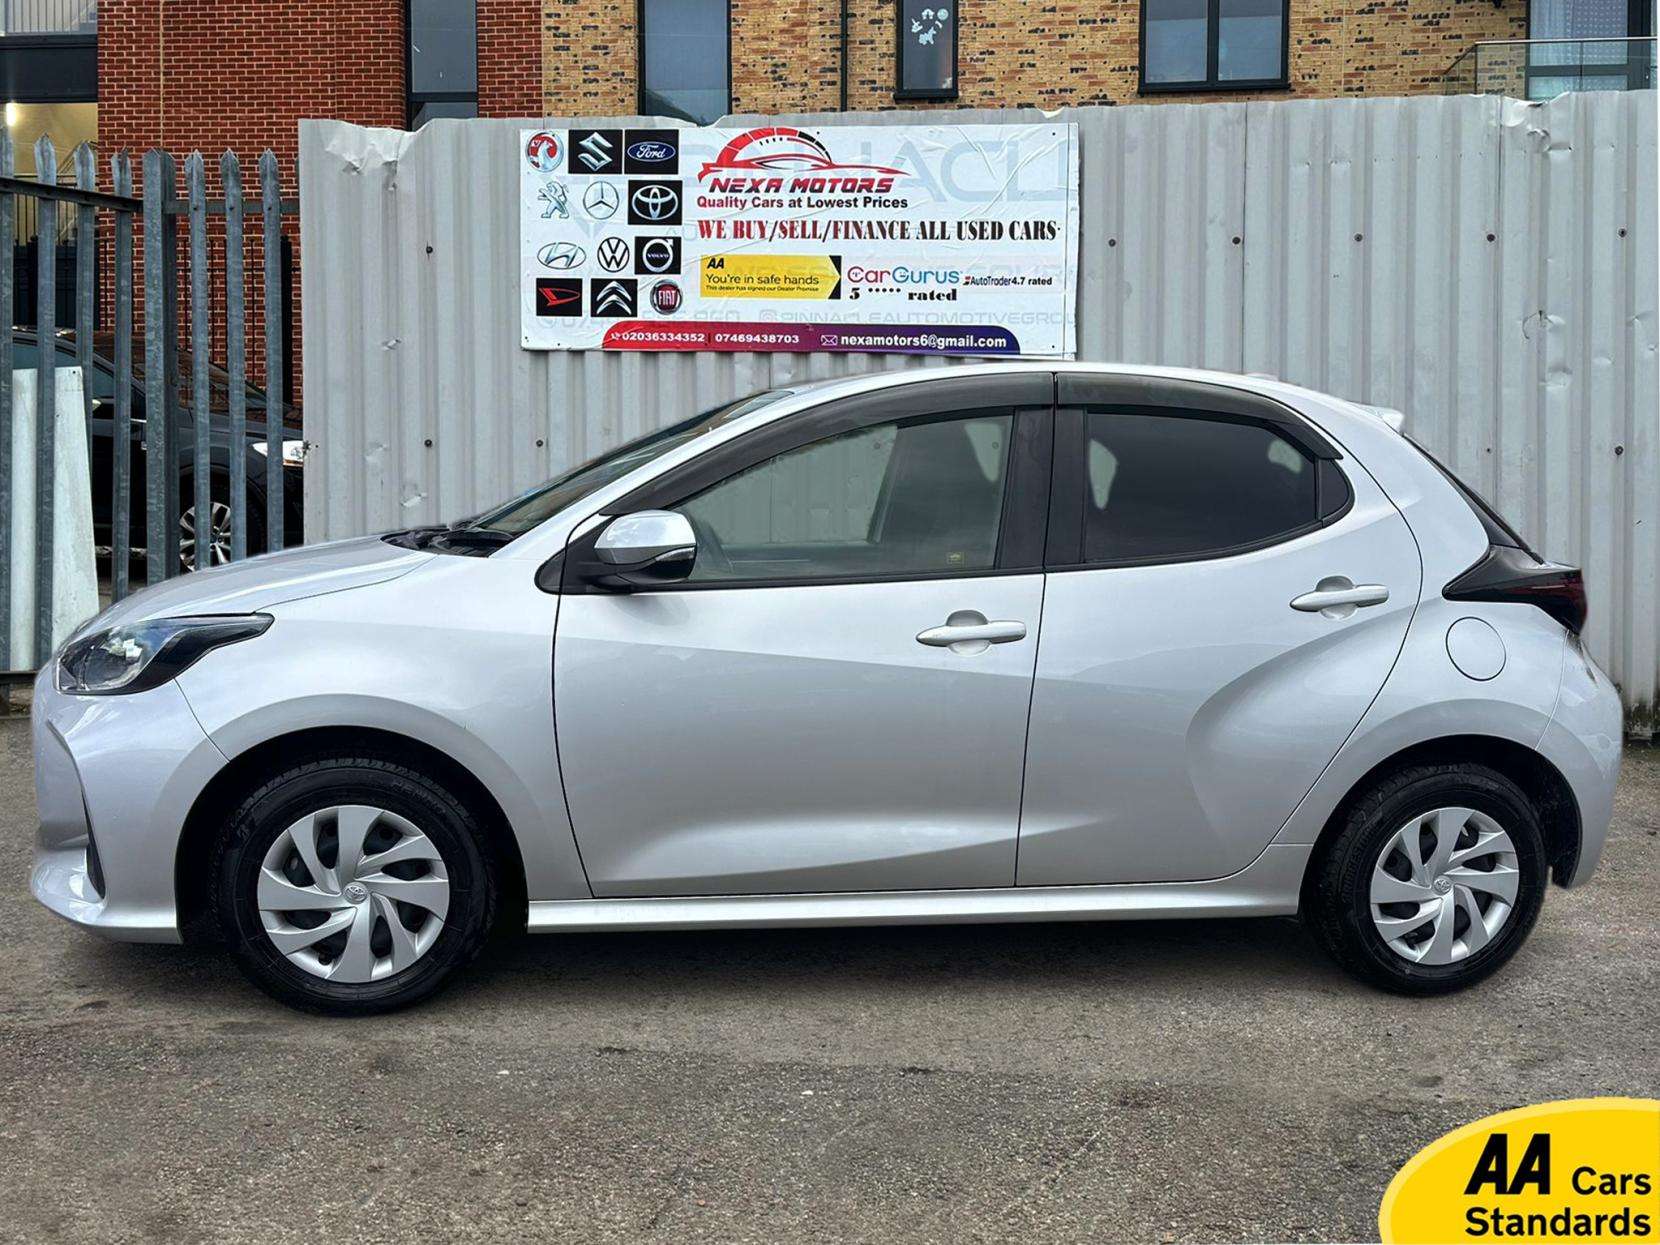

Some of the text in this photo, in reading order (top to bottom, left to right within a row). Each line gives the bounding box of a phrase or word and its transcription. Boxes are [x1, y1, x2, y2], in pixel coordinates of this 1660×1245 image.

[636, 144, 666, 160] Ford
[708, 177, 895, 194] NEXA MOTORS
[697, 196, 908, 210] Quality Cars at Lowest Prices
[698, 219, 727, 241] WE
[732, 219, 911, 243] BUY/SELL/FINANCE
[916, 220, 951, 241] ALL
[957, 220, 1004, 241] USED
[1009, 220, 1058, 241] CARS
[706, 257, 725, 270] AA
[706, 273, 820, 285] You're in safe hands
[847, 265, 960, 285] CarGurus
[970, 275, 1053, 286] AutoTrader 4.7 rated
[658, 290, 676, 306] FIAT
[849, 287, 958, 301] 5 rated
[621, 331, 1007, 350] 02036334352 07469438703 nexamotors6@gmail.com
